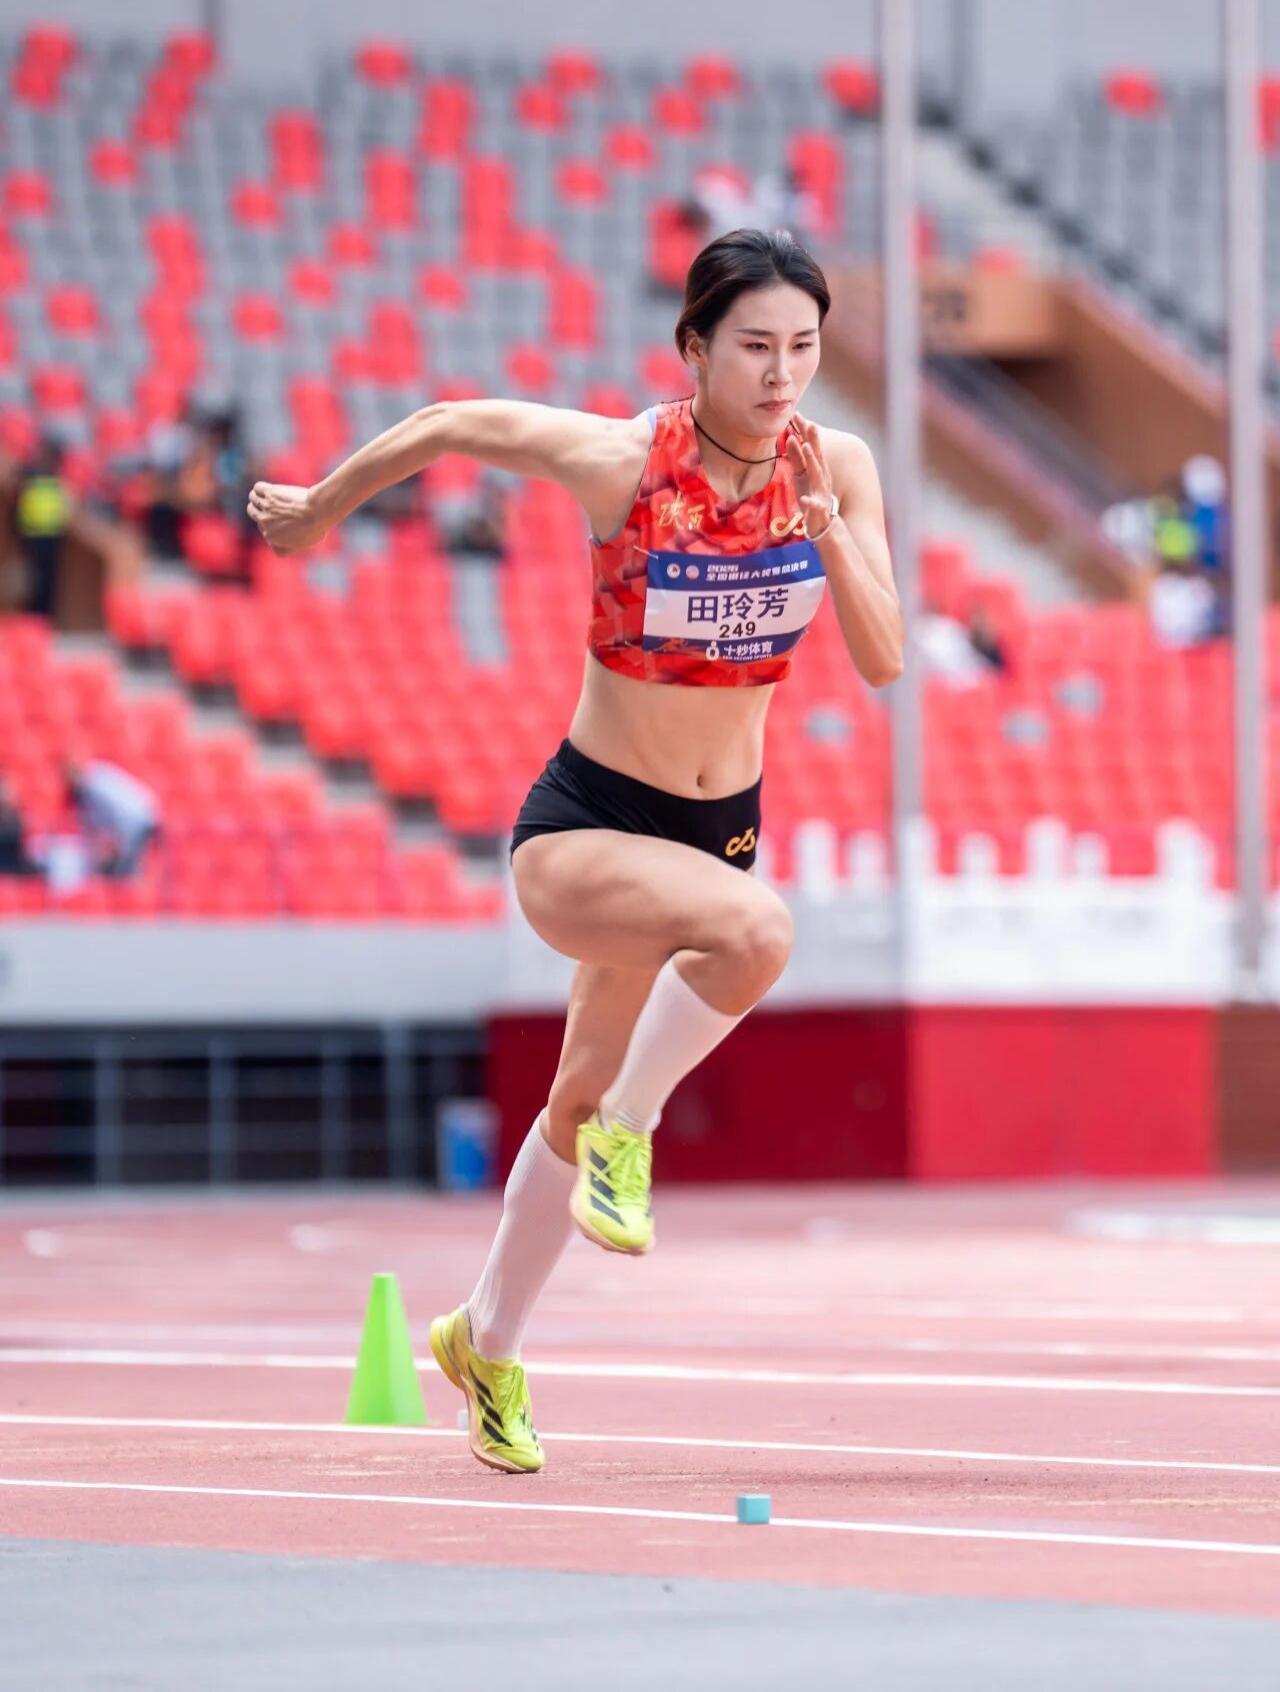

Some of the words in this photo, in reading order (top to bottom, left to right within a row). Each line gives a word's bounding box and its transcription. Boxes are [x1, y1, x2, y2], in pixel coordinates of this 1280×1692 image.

[687, 587, 789, 624] 田玲芳
[718, 621, 757, 639] 249
[723, 641, 774, 657] 十秒体育
